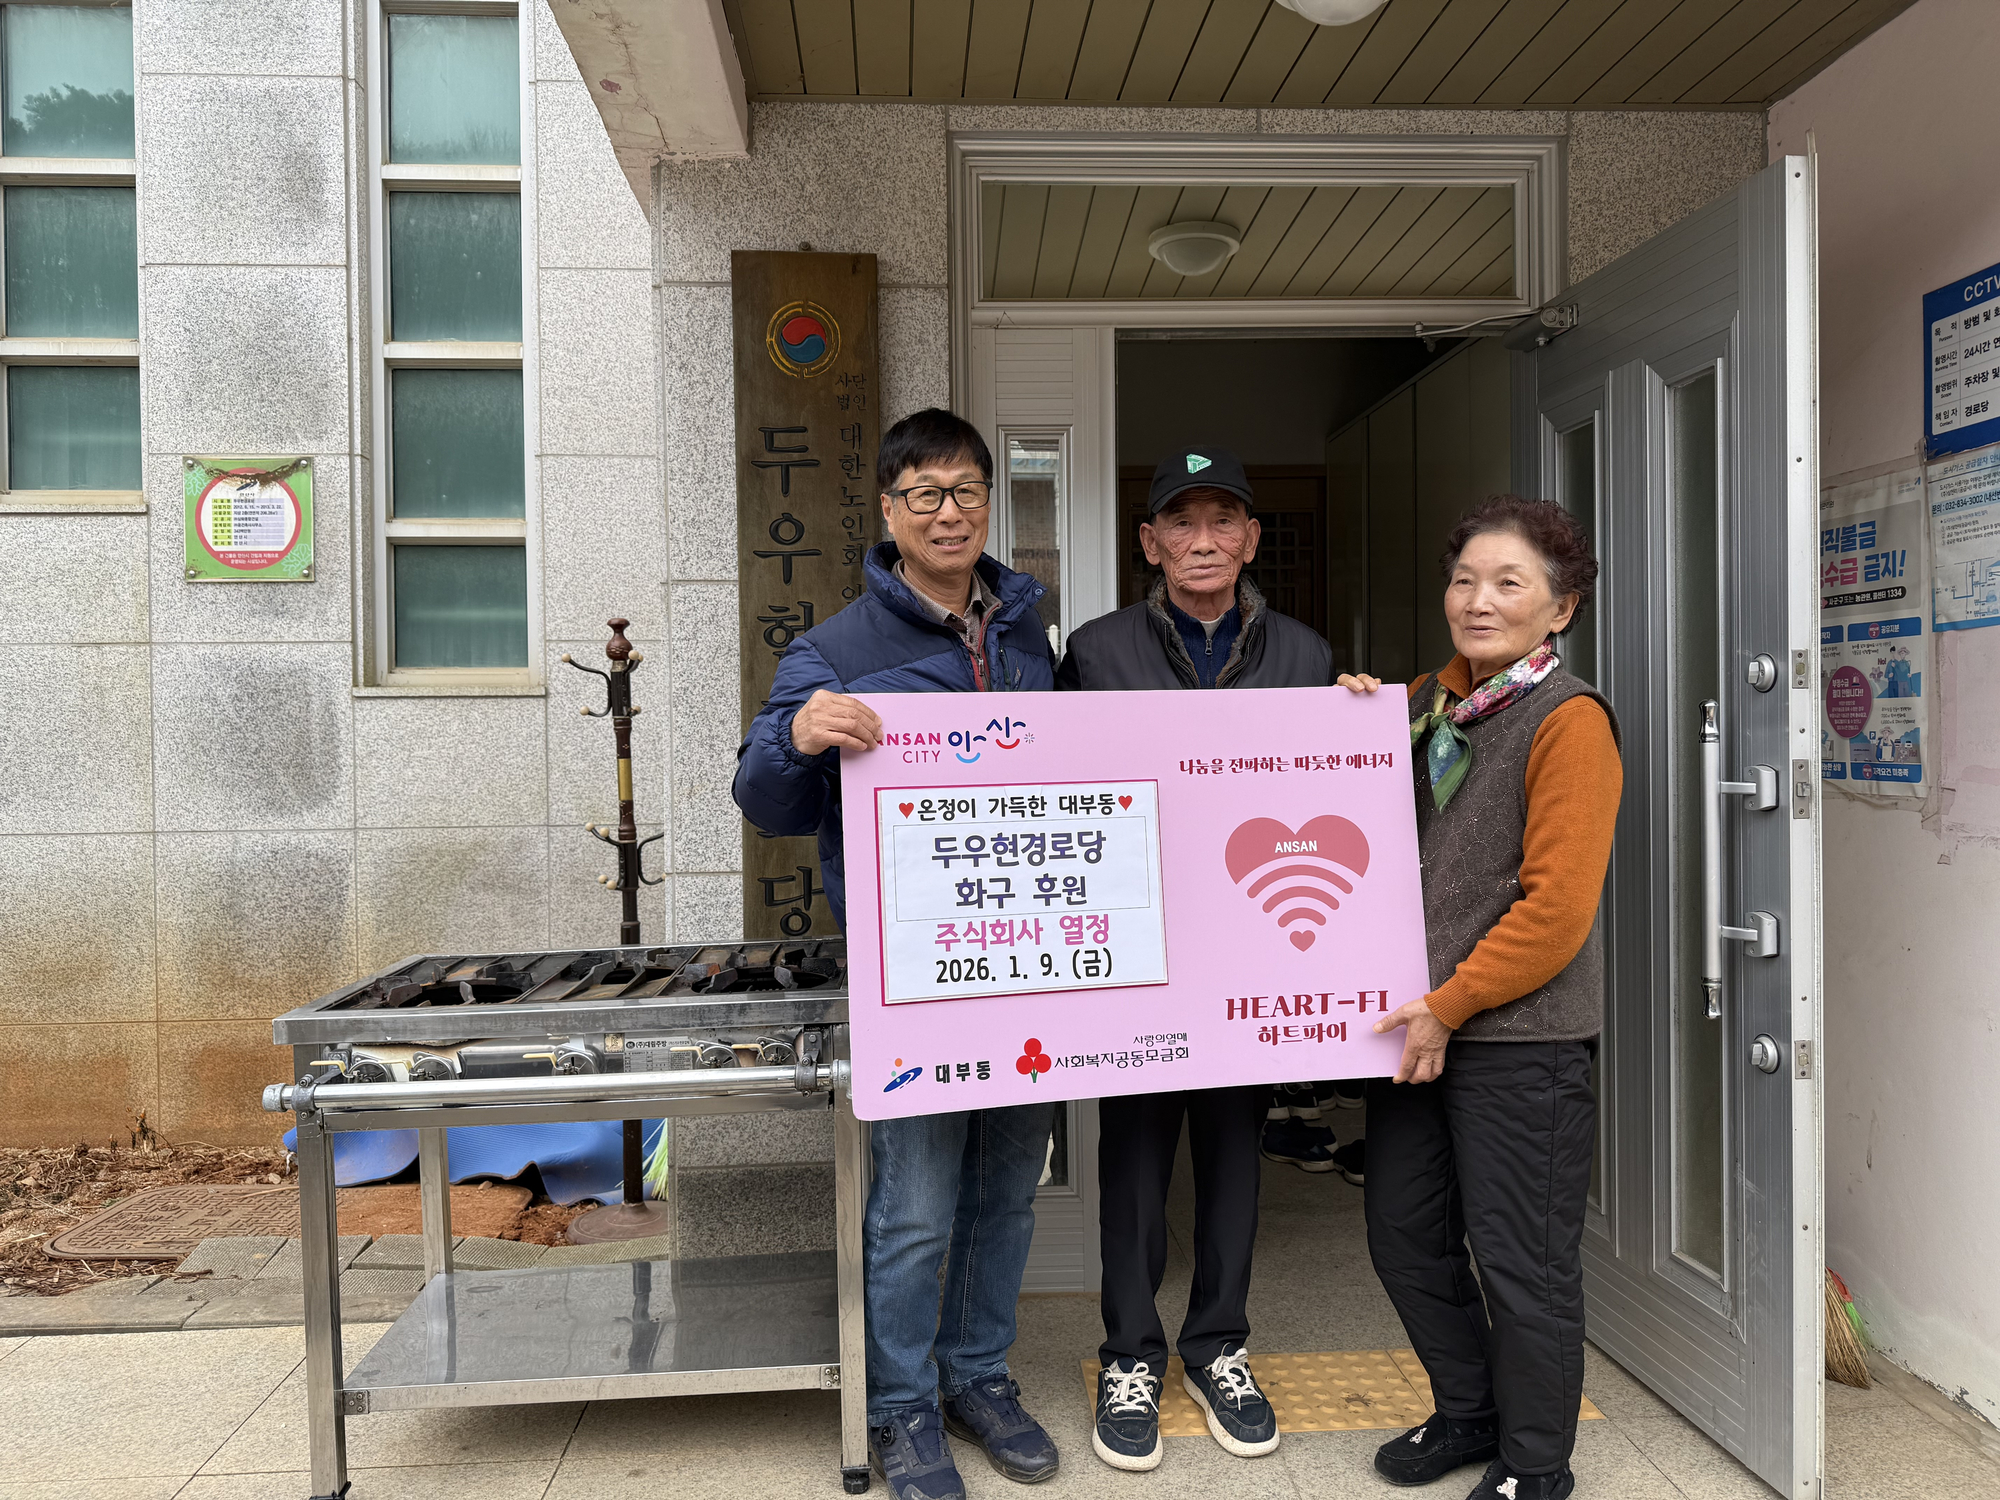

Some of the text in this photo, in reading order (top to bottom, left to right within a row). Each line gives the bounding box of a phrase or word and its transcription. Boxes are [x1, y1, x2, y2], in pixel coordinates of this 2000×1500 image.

[1963, 314, 1980, 330] 방범
[1983, 309, 1991, 322] 및
[1938, 334, 1953, 343] Purpose
[1934, 350, 1958, 366] 촬영시간
[1963, 341, 1991, 360] 24시간
[835, 372, 867, 391] 사단
[1934, 378, 1958, 394] 촬영범위
[1964, 371, 1989, 388] 주차장
[836, 393, 867, 411] 법인
[1964, 400, 1989, 418] 경로당
[1939, 419, 1953, 428] Contact
[838, 422, 867, 570] 대한노인회
[1944, 494, 1983, 511] 032-834-3002
[1863, 549, 1907, 582] 금지!
[1887, 588, 1902, 598] 1334
[902, 750, 941, 763] CITY
[1179, 752, 1393, 775] 나눔을 전파하는 따듯한 에너지
[917, 793, 1116, 821] 온정이 가득한 대부동
[931, 830, 1107, 869] 두우현경로당
[1274, 840, 1318, 853] ANSAN
[954, 873, 1087, 910] 화구 후원
[934, 913, 1110, 952] 주식회사 열정
[935, 947, 1112, 983] 2026. 1. 9. (금)
[1225, 990, 1389, 1021] HEART-FI
[1132, 1032, 1188, 1048] 사랑의열매
[1257, 1021, 1347, 1046] 하트파이
[1054, 1046, 1190, 1069] 사회복지공동모금회
[935, 1060, 991, 1084] 대부동
